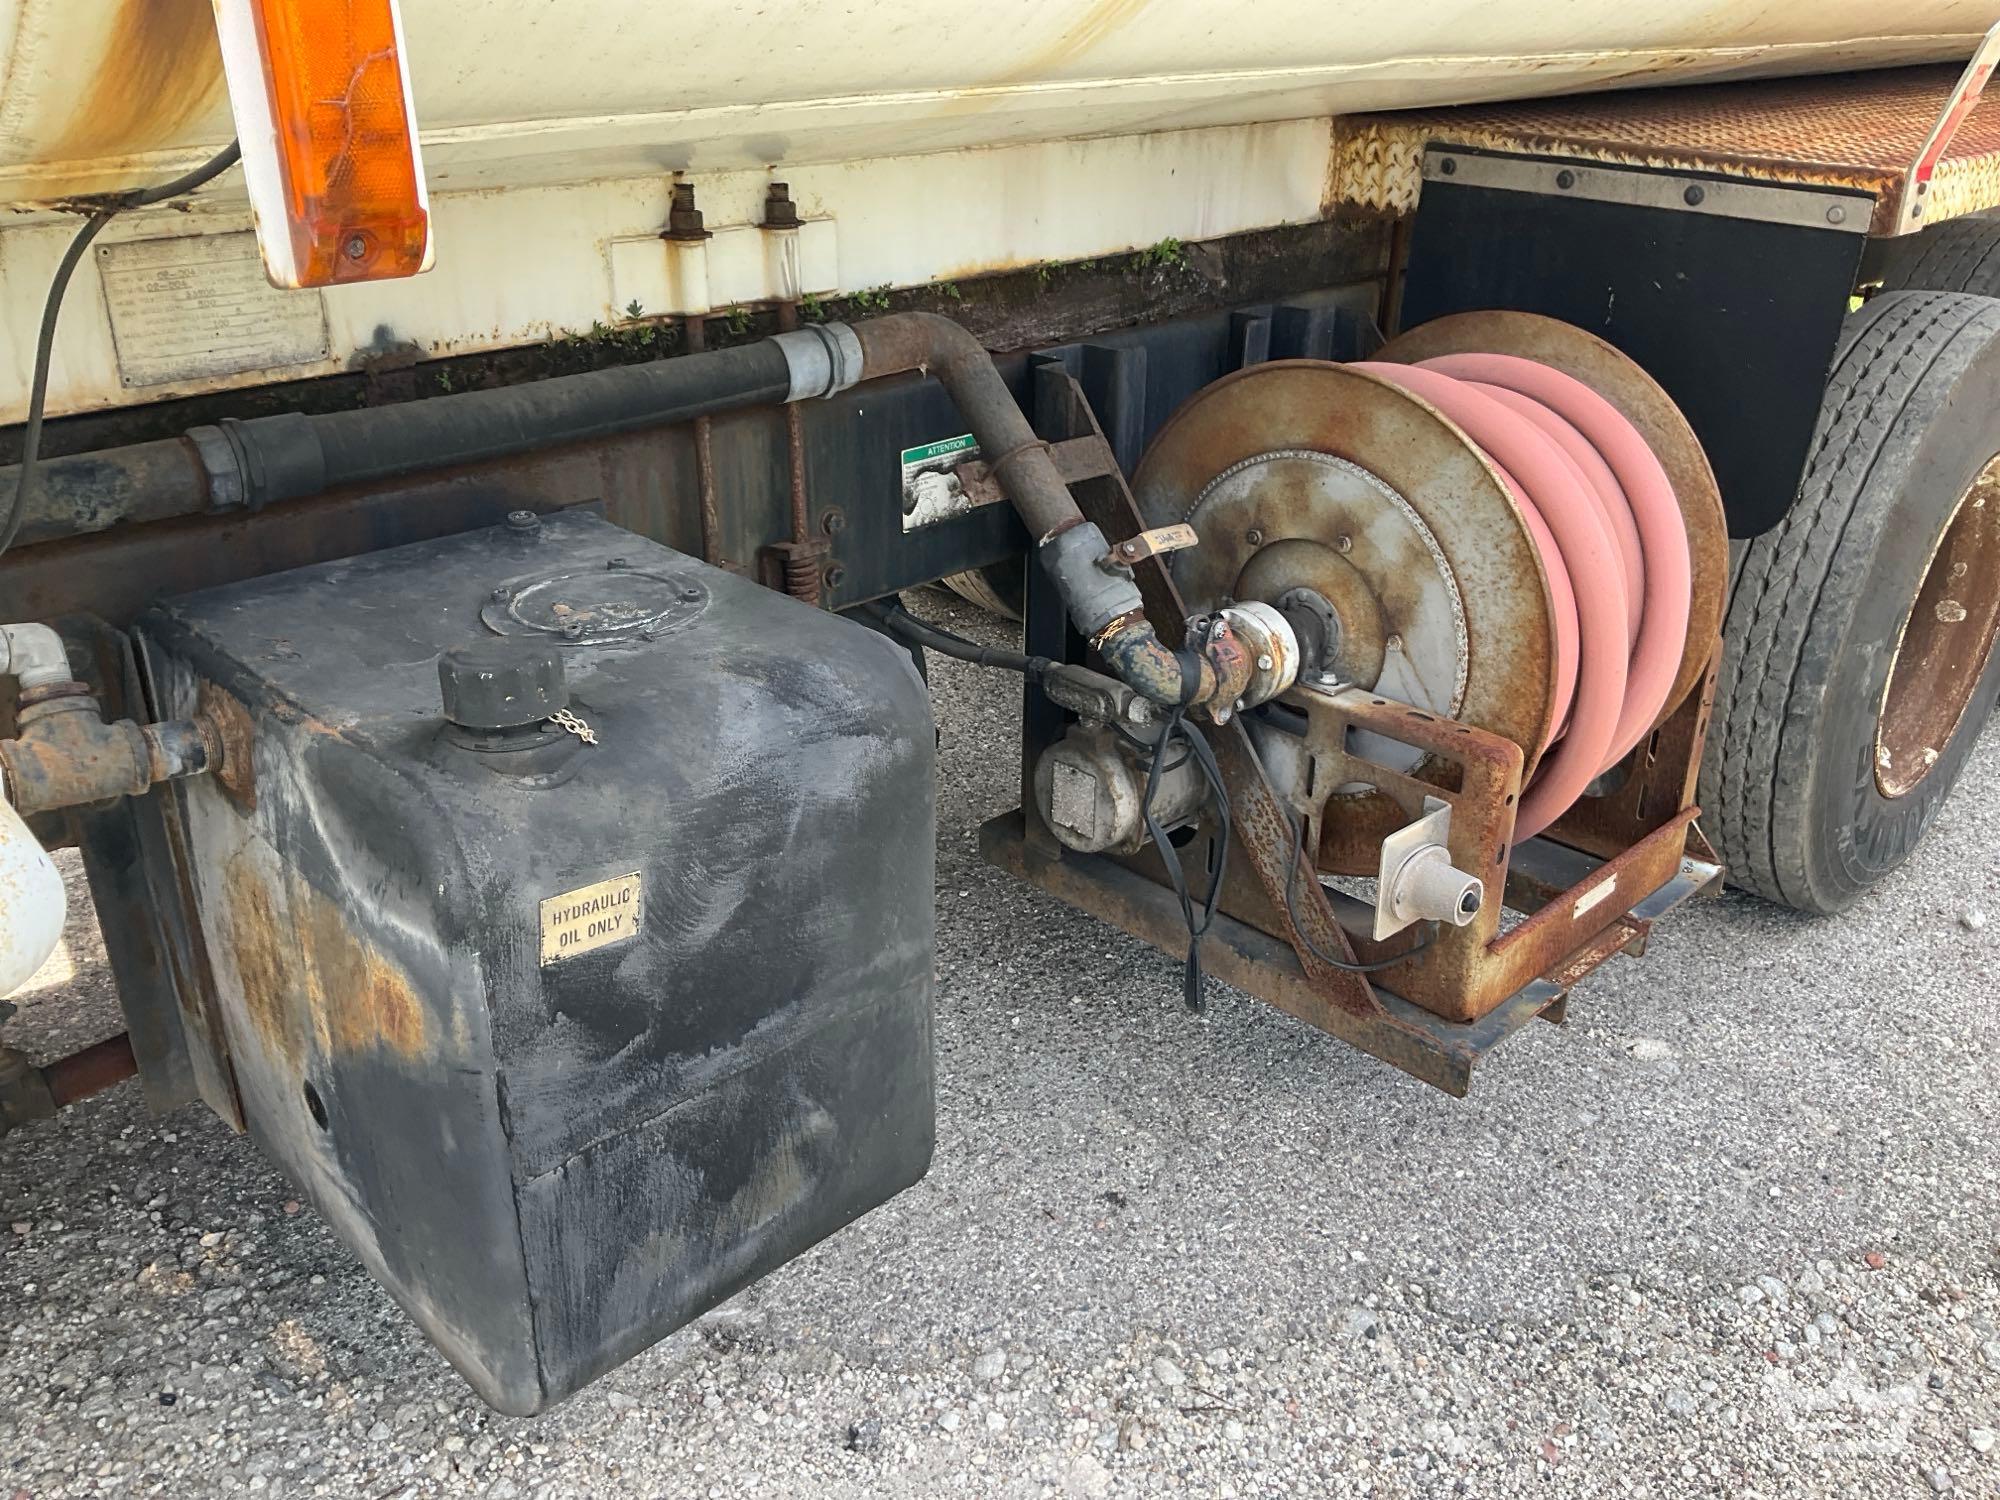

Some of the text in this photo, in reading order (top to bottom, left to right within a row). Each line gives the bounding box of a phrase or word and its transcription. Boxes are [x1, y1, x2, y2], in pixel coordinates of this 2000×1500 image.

[928, 440, 965, 456] ATTENTION
[553, 888, 630, 925] HYDRAULIC
[560, 914, 622, 947] OIL ONLY
